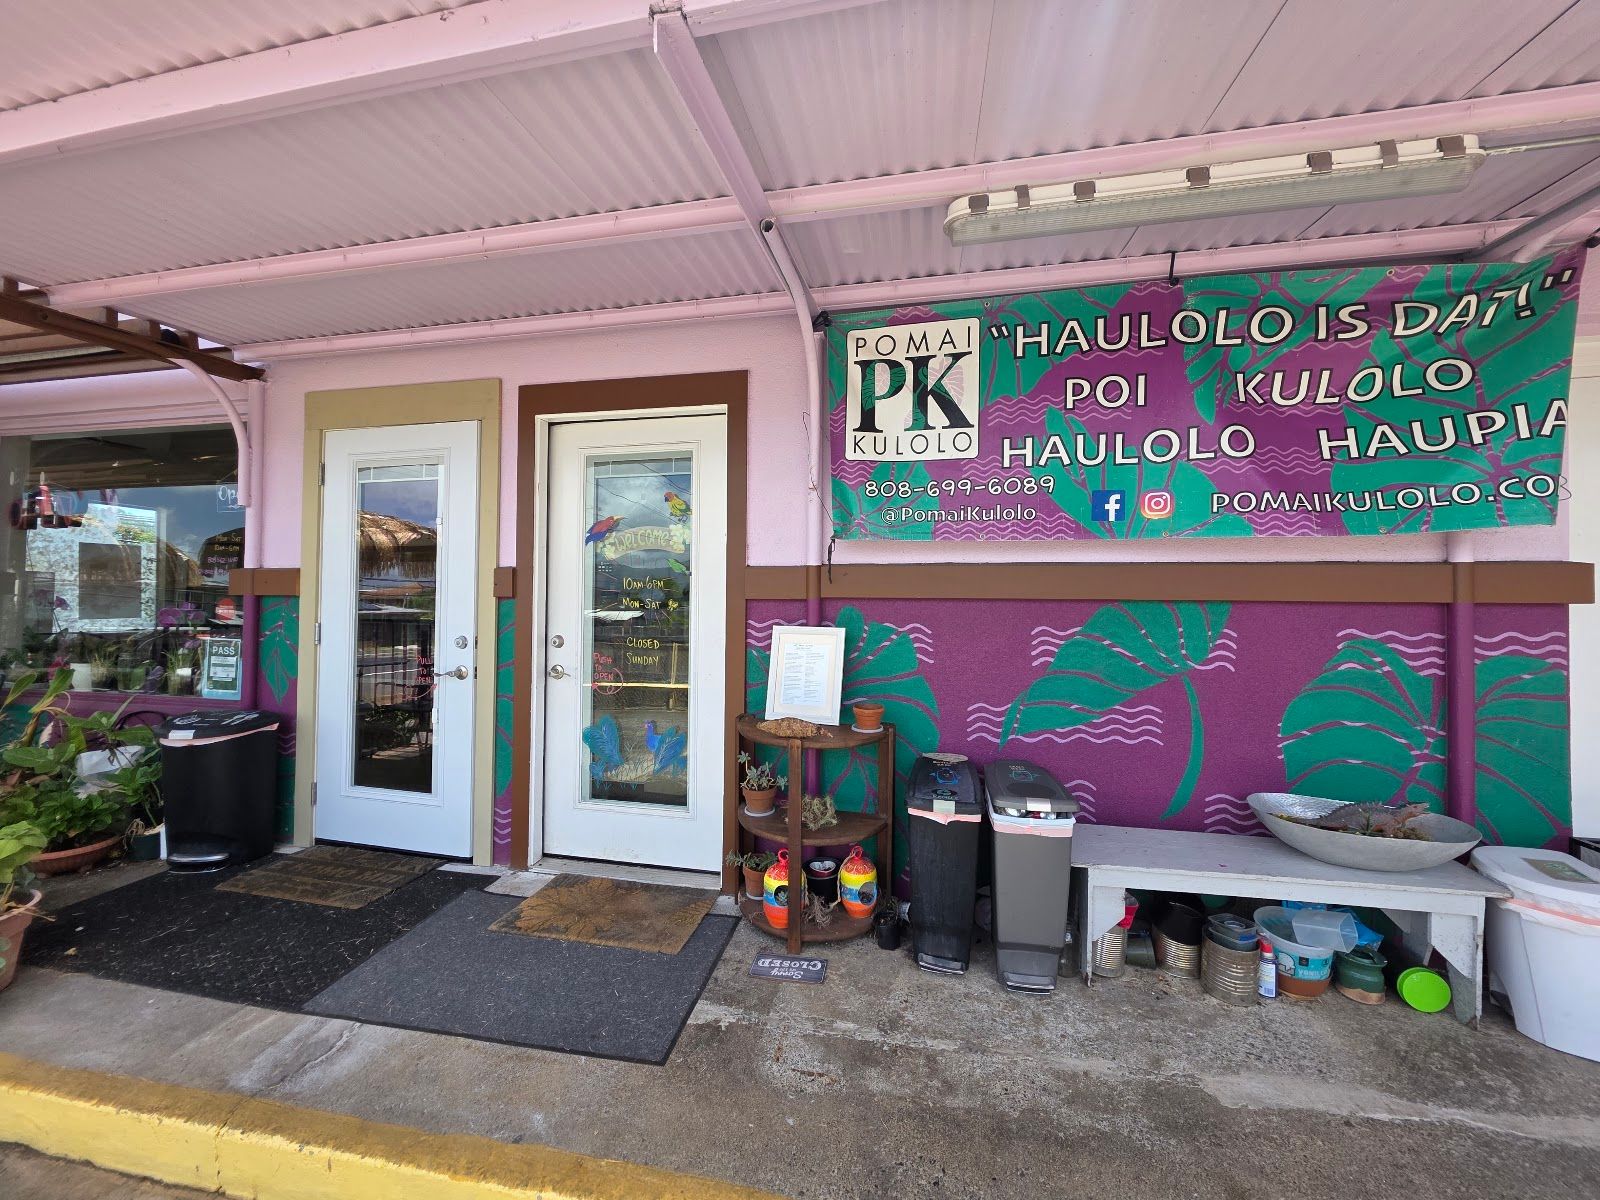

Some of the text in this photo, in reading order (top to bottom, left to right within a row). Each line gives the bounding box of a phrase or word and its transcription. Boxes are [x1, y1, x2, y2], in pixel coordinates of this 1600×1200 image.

[1314, 302, 1371, 343] IS
[855, 326, 972, 357] POMAI
[853, 351, 975, 433] PK
[1064, 357, 1476, 410] POI KULOLO
[852, 431, 973, 456] KULOLO
[1001, 397, 1568, 469] HAULOLO HAUPIA
[864, 475, 1056, 499] 808-699-6089
[1211, 473, 1560, 514] POMAIKULOLO.CO
[881, 503, 1037, 525] @PomaiKulolo
[212, 646, 235, 656] PASS
[626, 636, 660, 650] CLOSED
[625, 652, 659, 667] SUNDAY
[594, 672, 614, 681] OPEN
[757, 958, 822, 970] CLOSED
